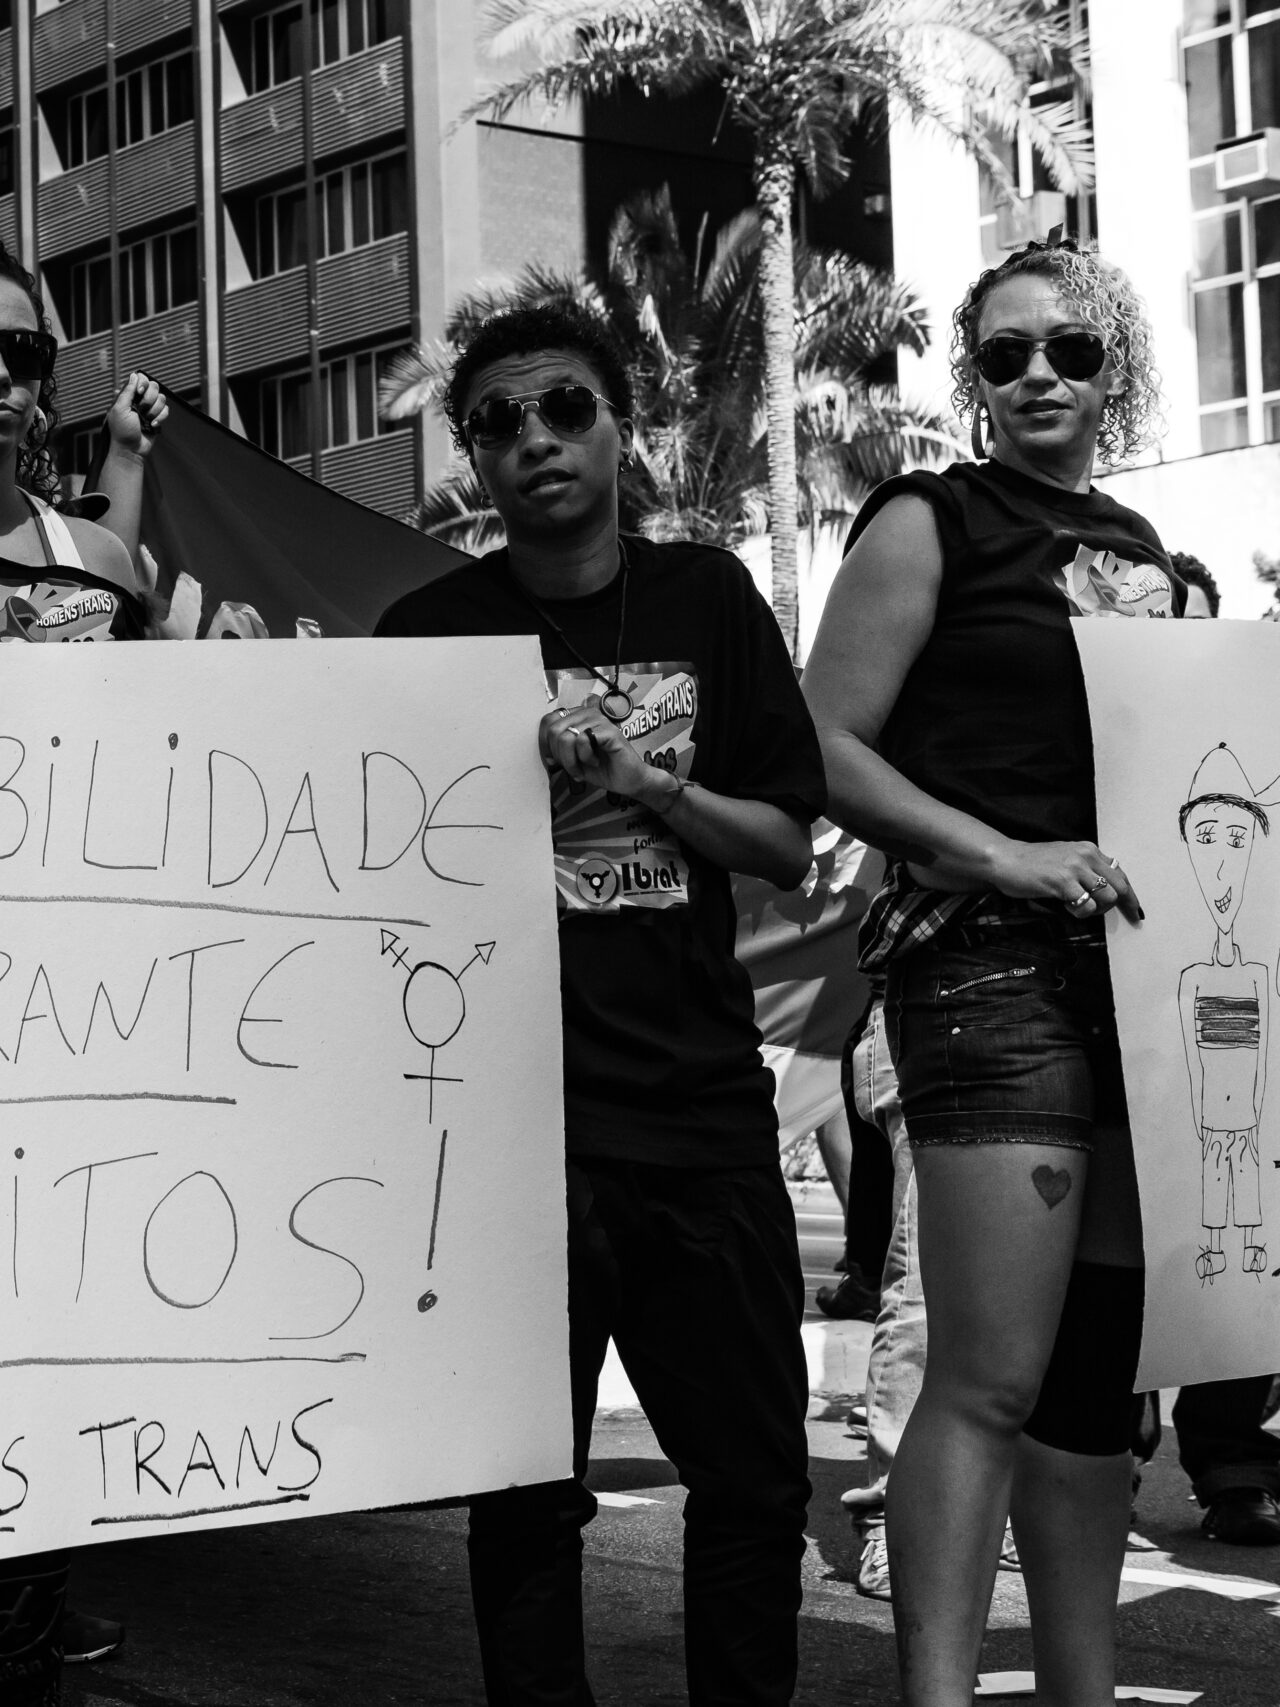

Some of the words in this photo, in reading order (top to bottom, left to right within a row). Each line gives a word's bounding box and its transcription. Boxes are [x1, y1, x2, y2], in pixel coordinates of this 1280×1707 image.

[36, 603, 80, 628] HOMENS
[78, 593, 113, 618] TRANS
[620, 701, 661, 741] OMENS
[660, 681, 694, 724] TRANS
[620, 861, 682, 891] Ibrat
[78, 1397, 335, 1500] TRANS
